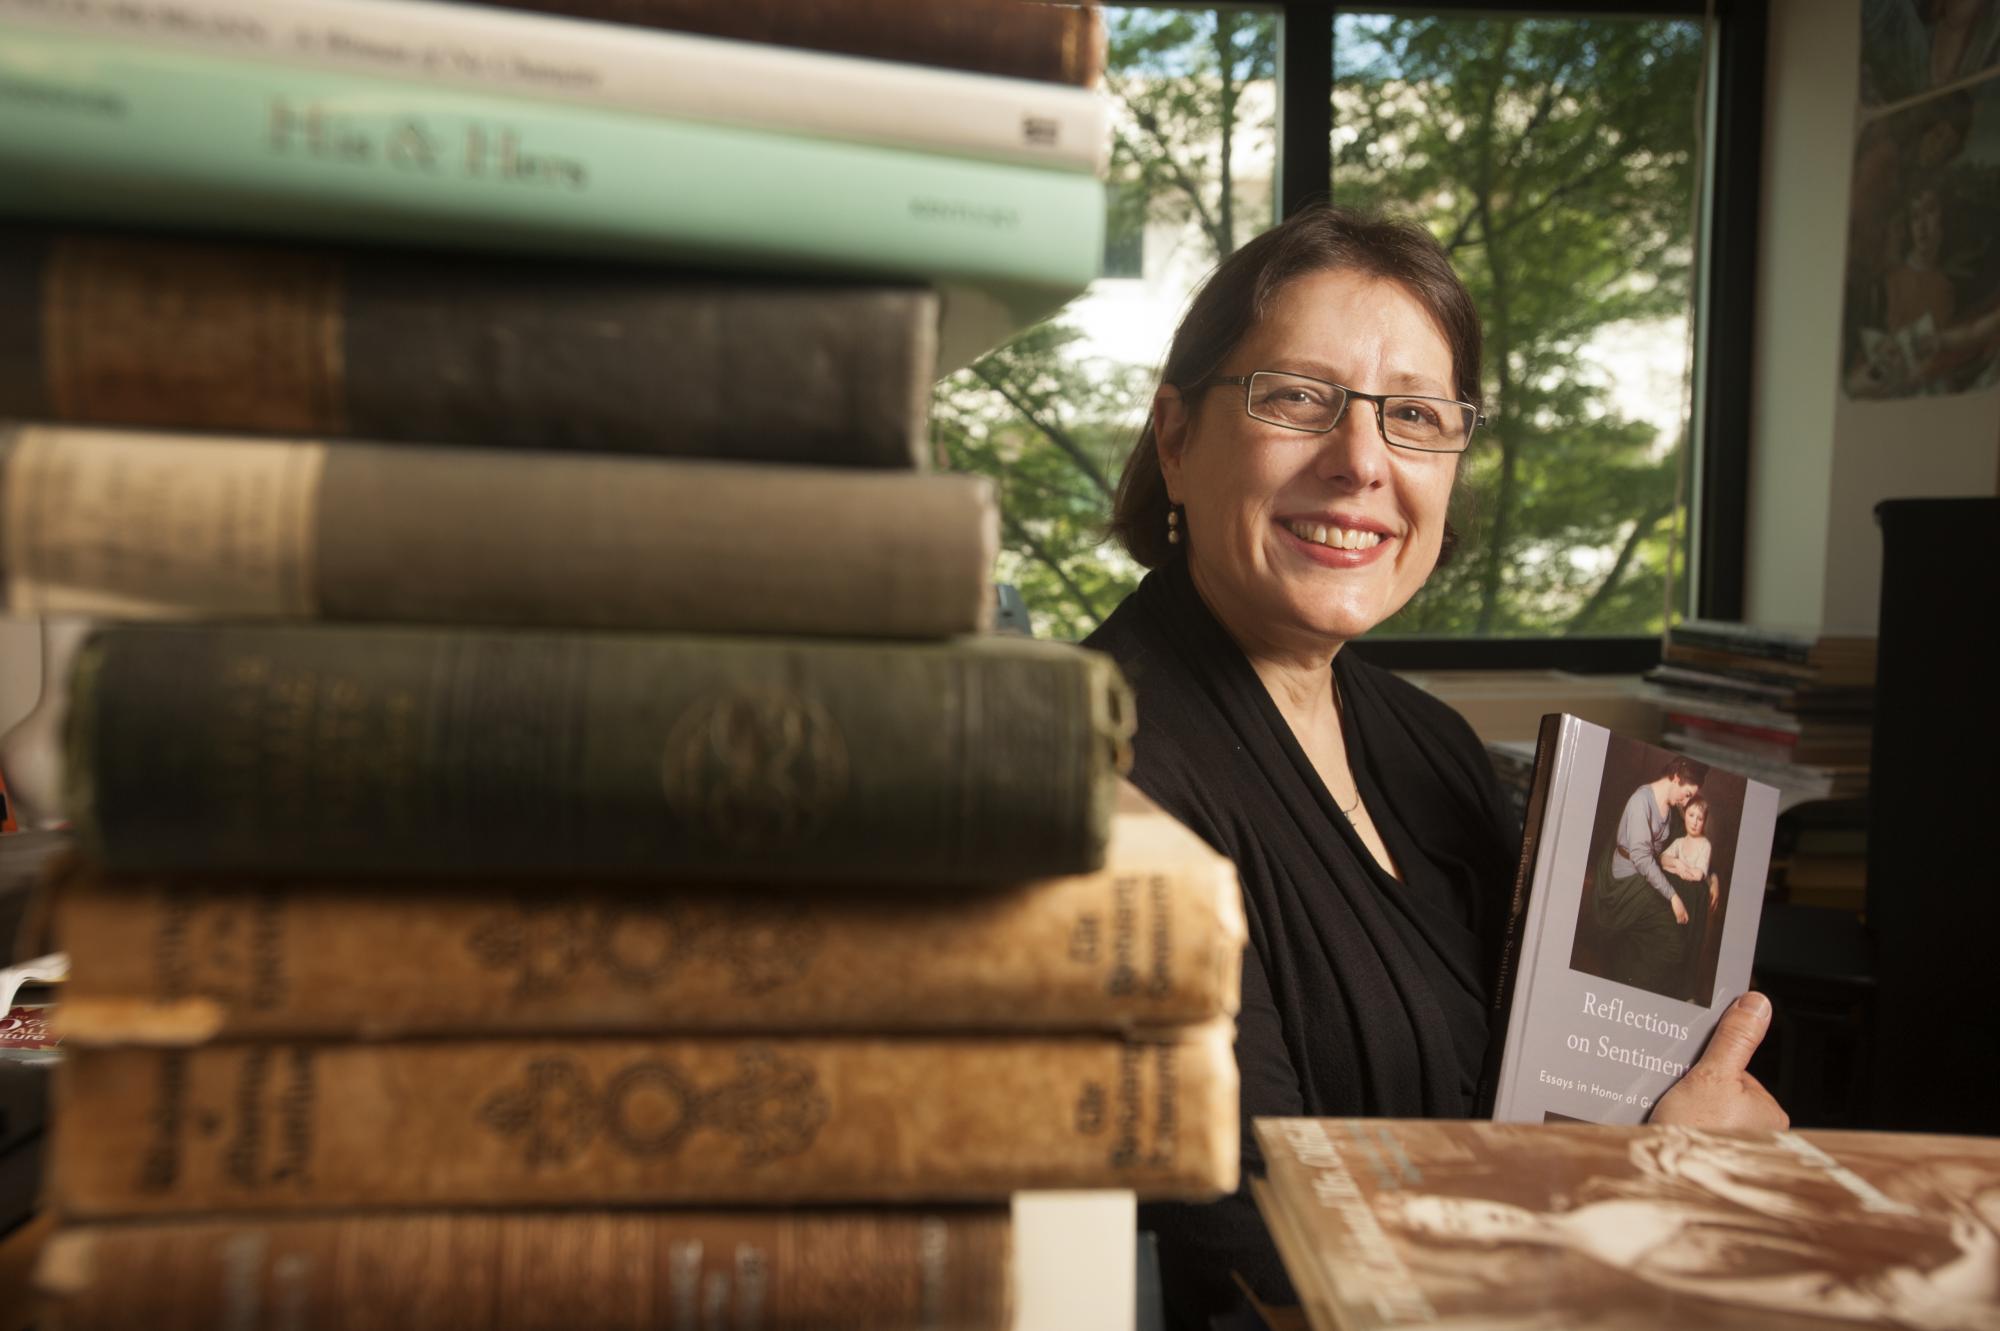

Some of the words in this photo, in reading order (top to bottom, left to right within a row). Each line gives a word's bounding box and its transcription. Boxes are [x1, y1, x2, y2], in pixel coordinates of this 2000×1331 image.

[1512, 836, 1532, 912] Reflections
[1582, 992, 1689, 1041] Reflections
[1567, 1033, 1590, 1053] on
[1539, 1070, 1574, 1090] Essays
[1577, 1080, 1587, 1093] in
[1591, 1083, 1623, 1102] Honor
[1626, 1094, 1637, 1105] of
